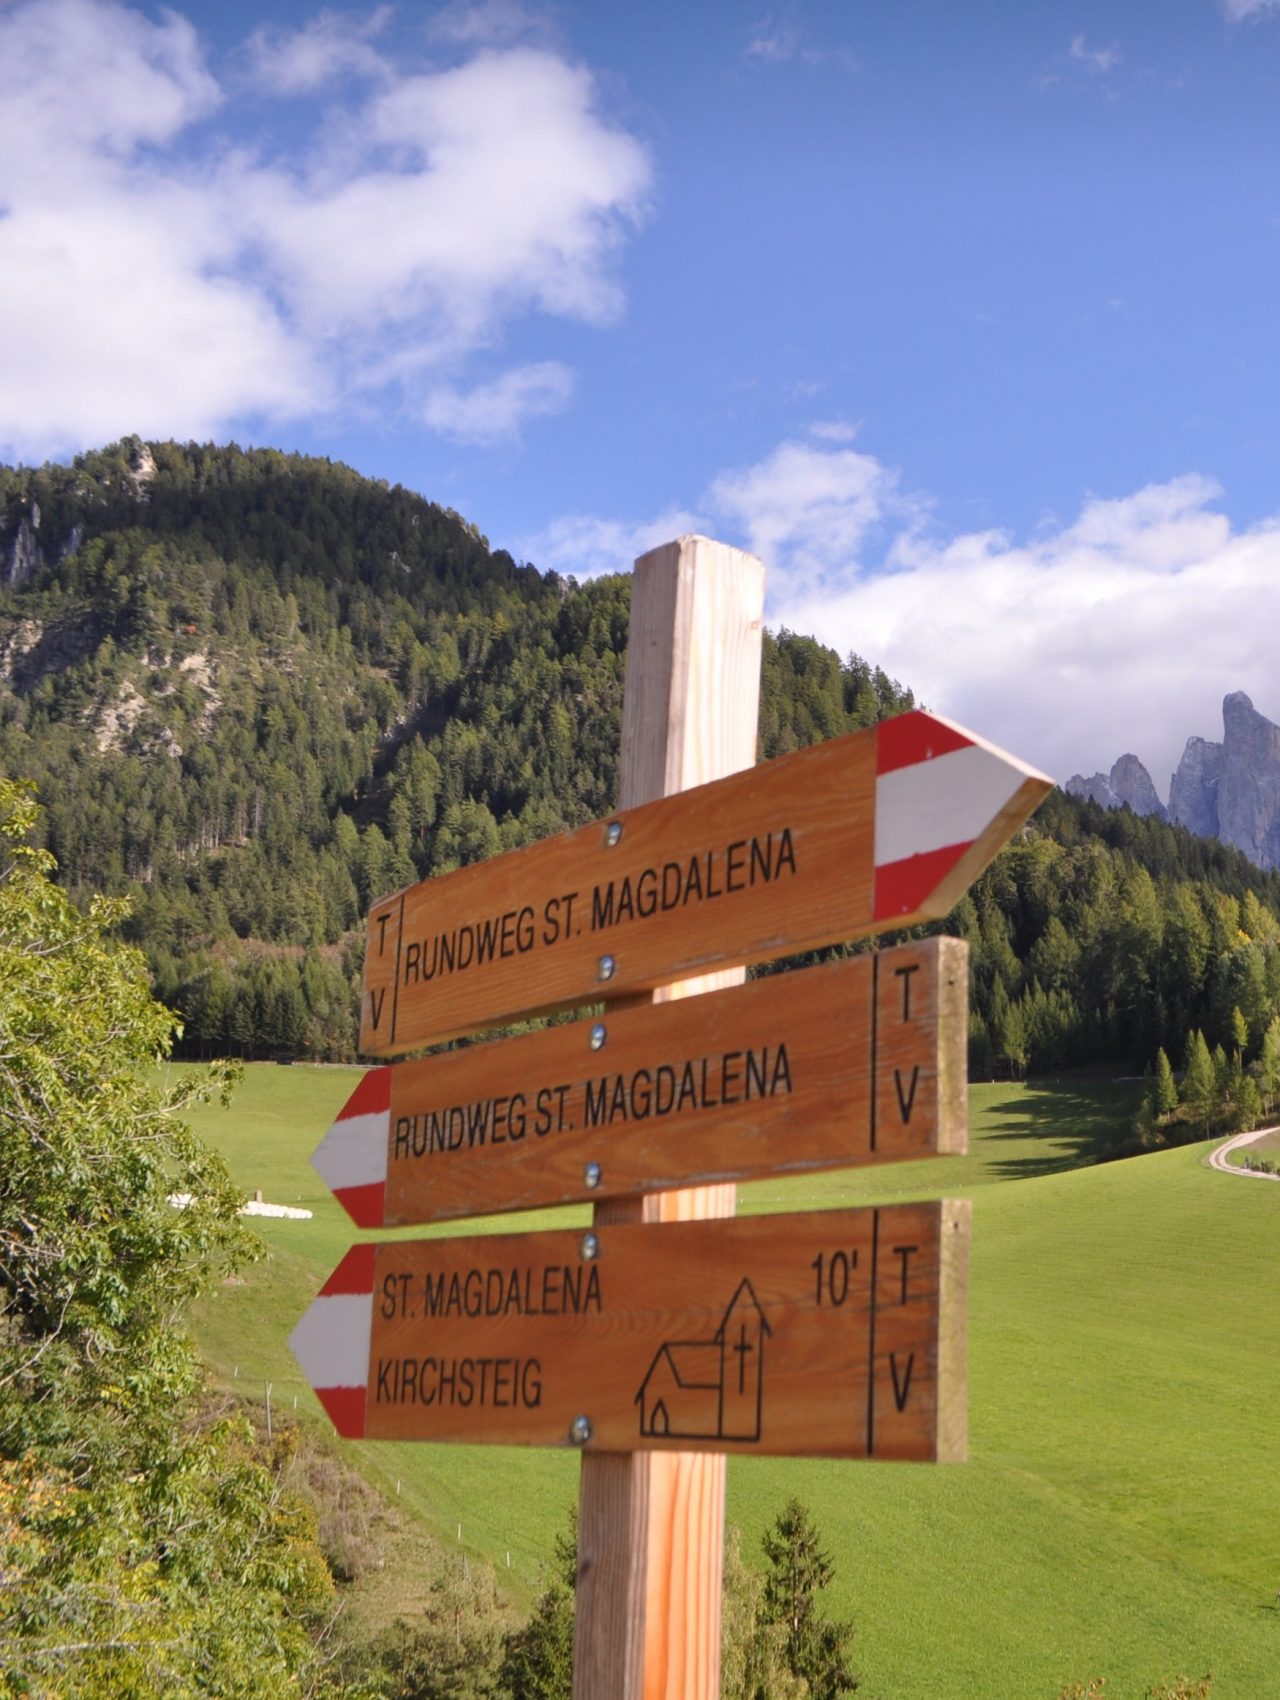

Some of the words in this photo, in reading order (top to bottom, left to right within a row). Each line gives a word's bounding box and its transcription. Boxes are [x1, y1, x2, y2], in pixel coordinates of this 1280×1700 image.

[405, 907, 534, 984] RUNDWEG
[543, 893, 581, 945] ST.
[591, 827, 796, 931] MAGDALENA
[377, 914, 391, 957] T
[371, 988, 386, 1031] V
[895, 965, 919, 1022] T
[395, 1094, 526, 1159] RUNDWEG
[533, 1084, 574, 1136] ST.
[584, 1043, 792, 1129] MAGDALENA
[894, 1065, 919, 1125] V
[381, 1273, 417, 1320] ST.
[425, 1265, 602, 1317] MAGDALENA
[811, 1249, 858, 1306] 10'
[892, 1246, 918, 1305] T
[377, 1357, 543, 1409] KIRCHSTEIG
[889, 1352, 915, 1413] V
